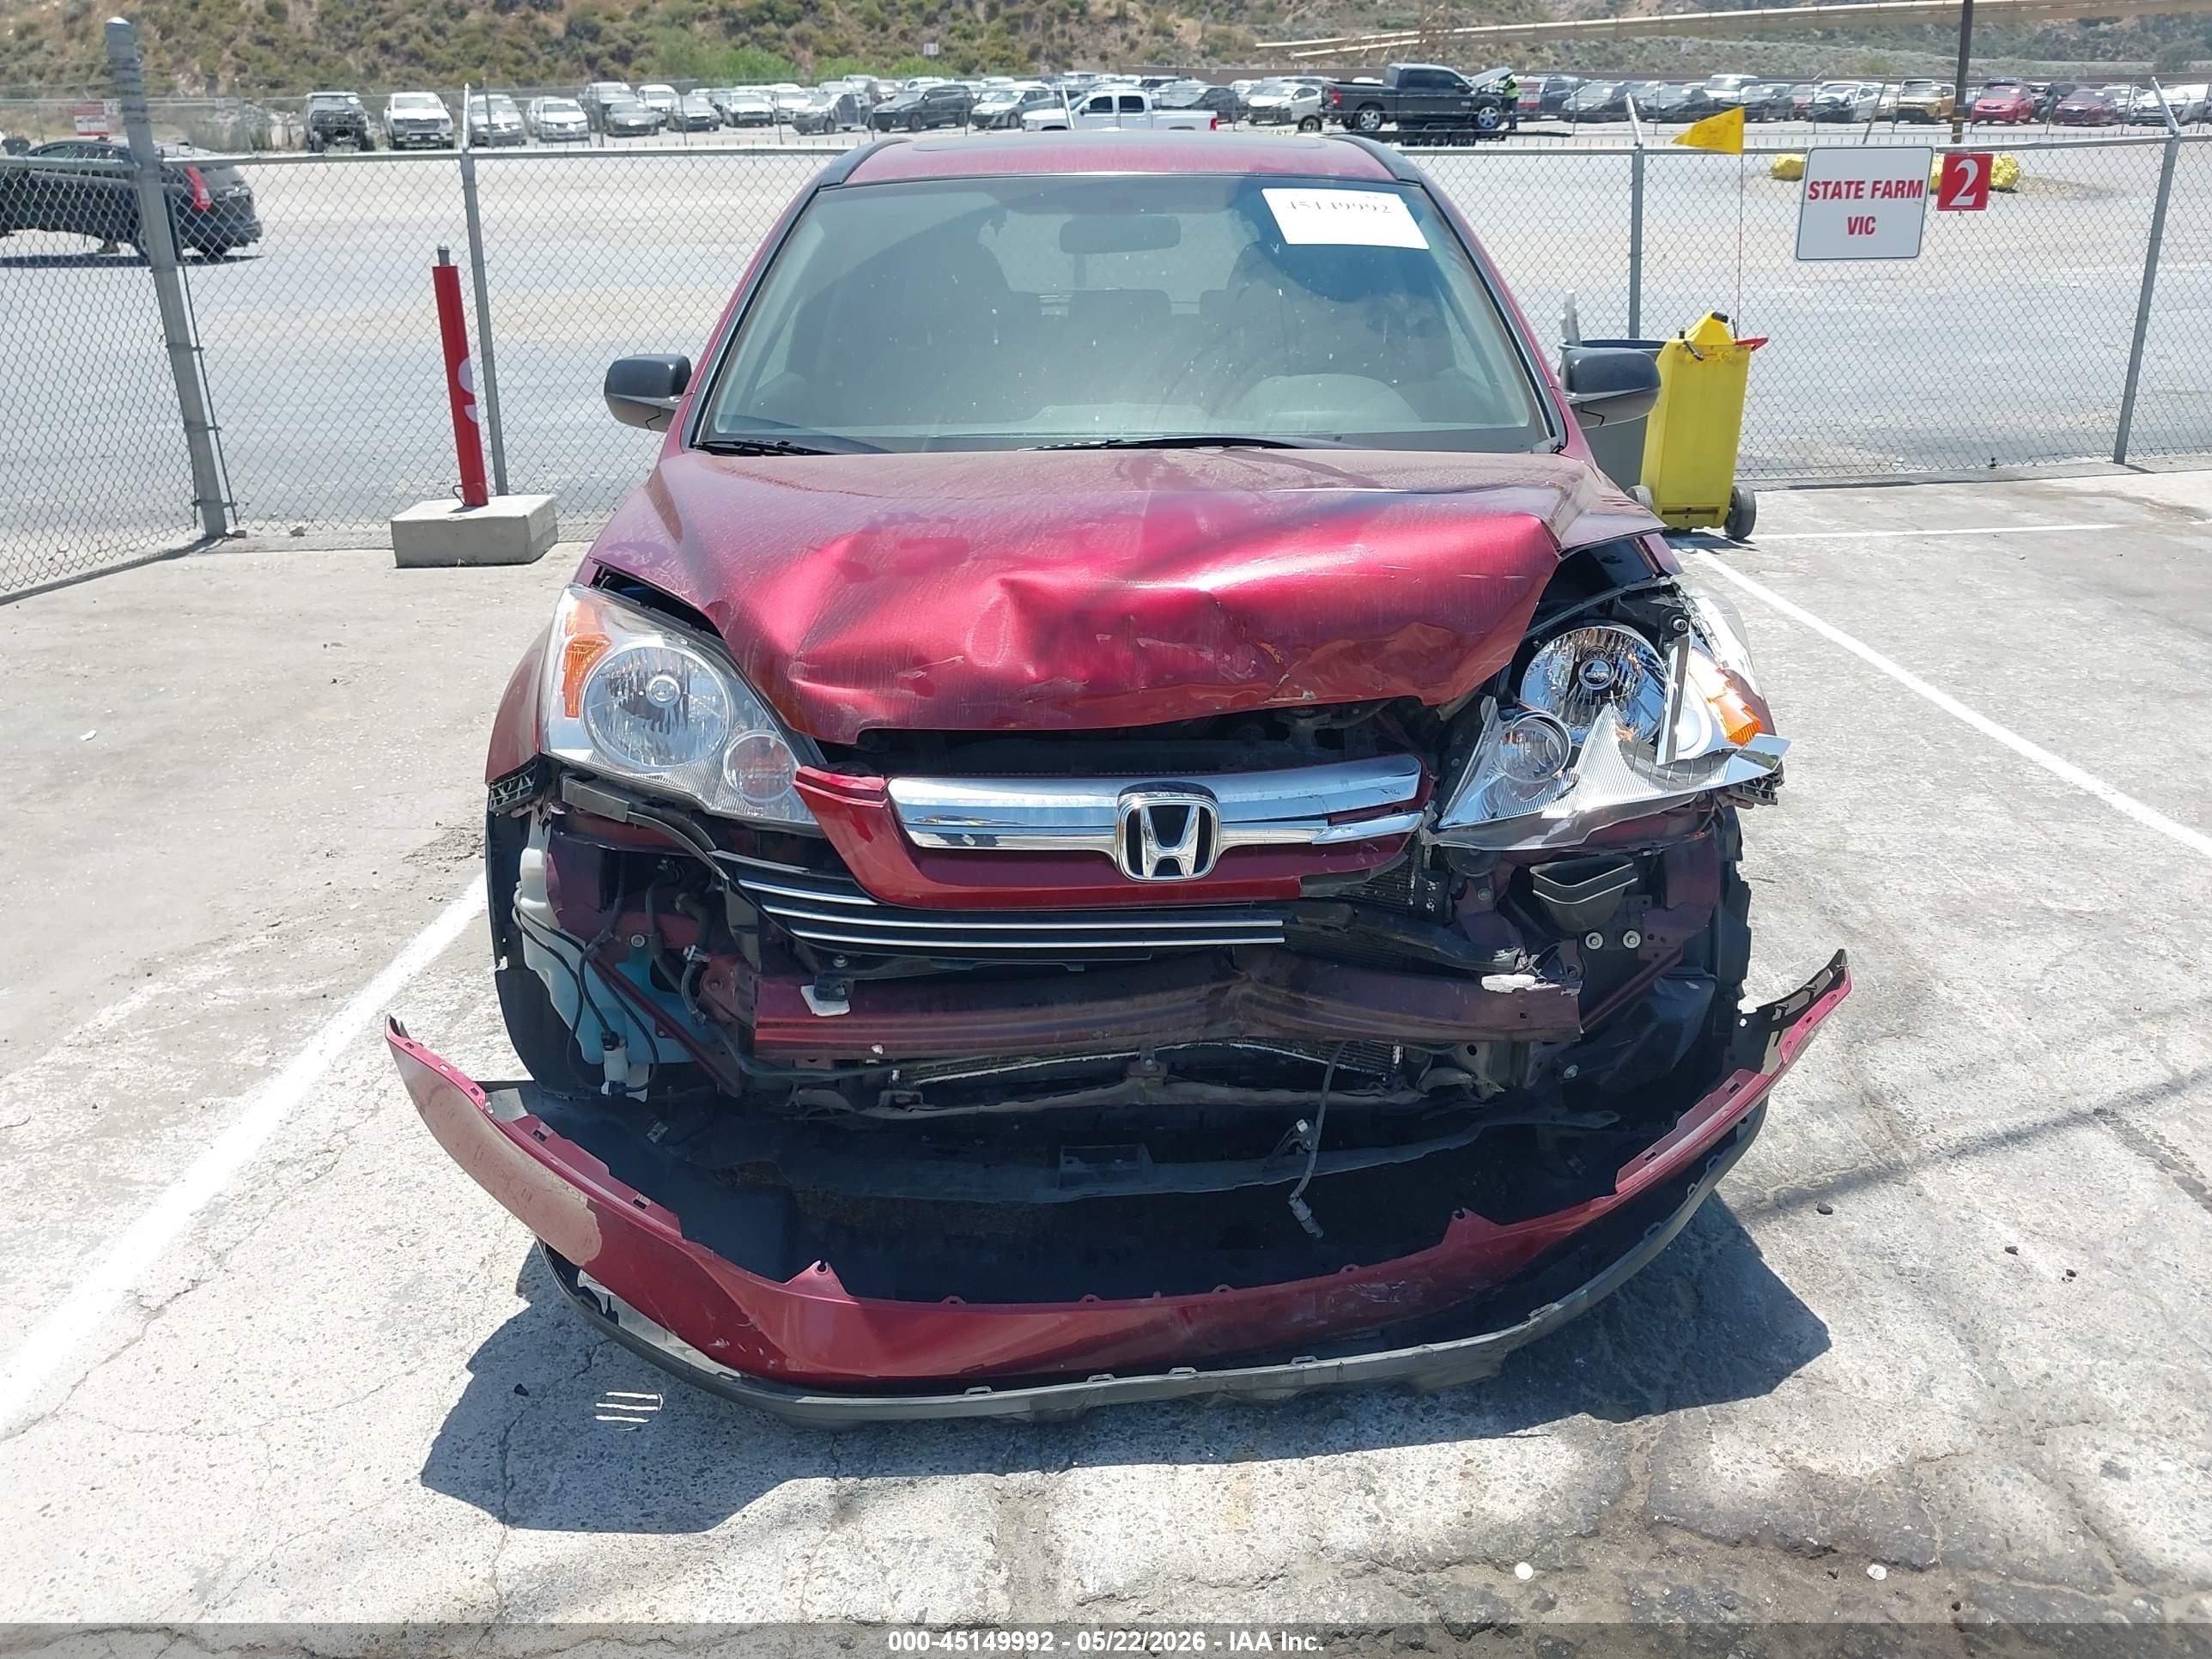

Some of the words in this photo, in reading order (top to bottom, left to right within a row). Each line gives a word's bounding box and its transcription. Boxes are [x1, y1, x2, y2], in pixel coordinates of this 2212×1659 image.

[1808, 179, 1865, 200] STATE
[1869, 179, 1924, 199] FARM
[1948, 159, 1979, 206] 2
[1847, 216, 1876, 235] VIC
